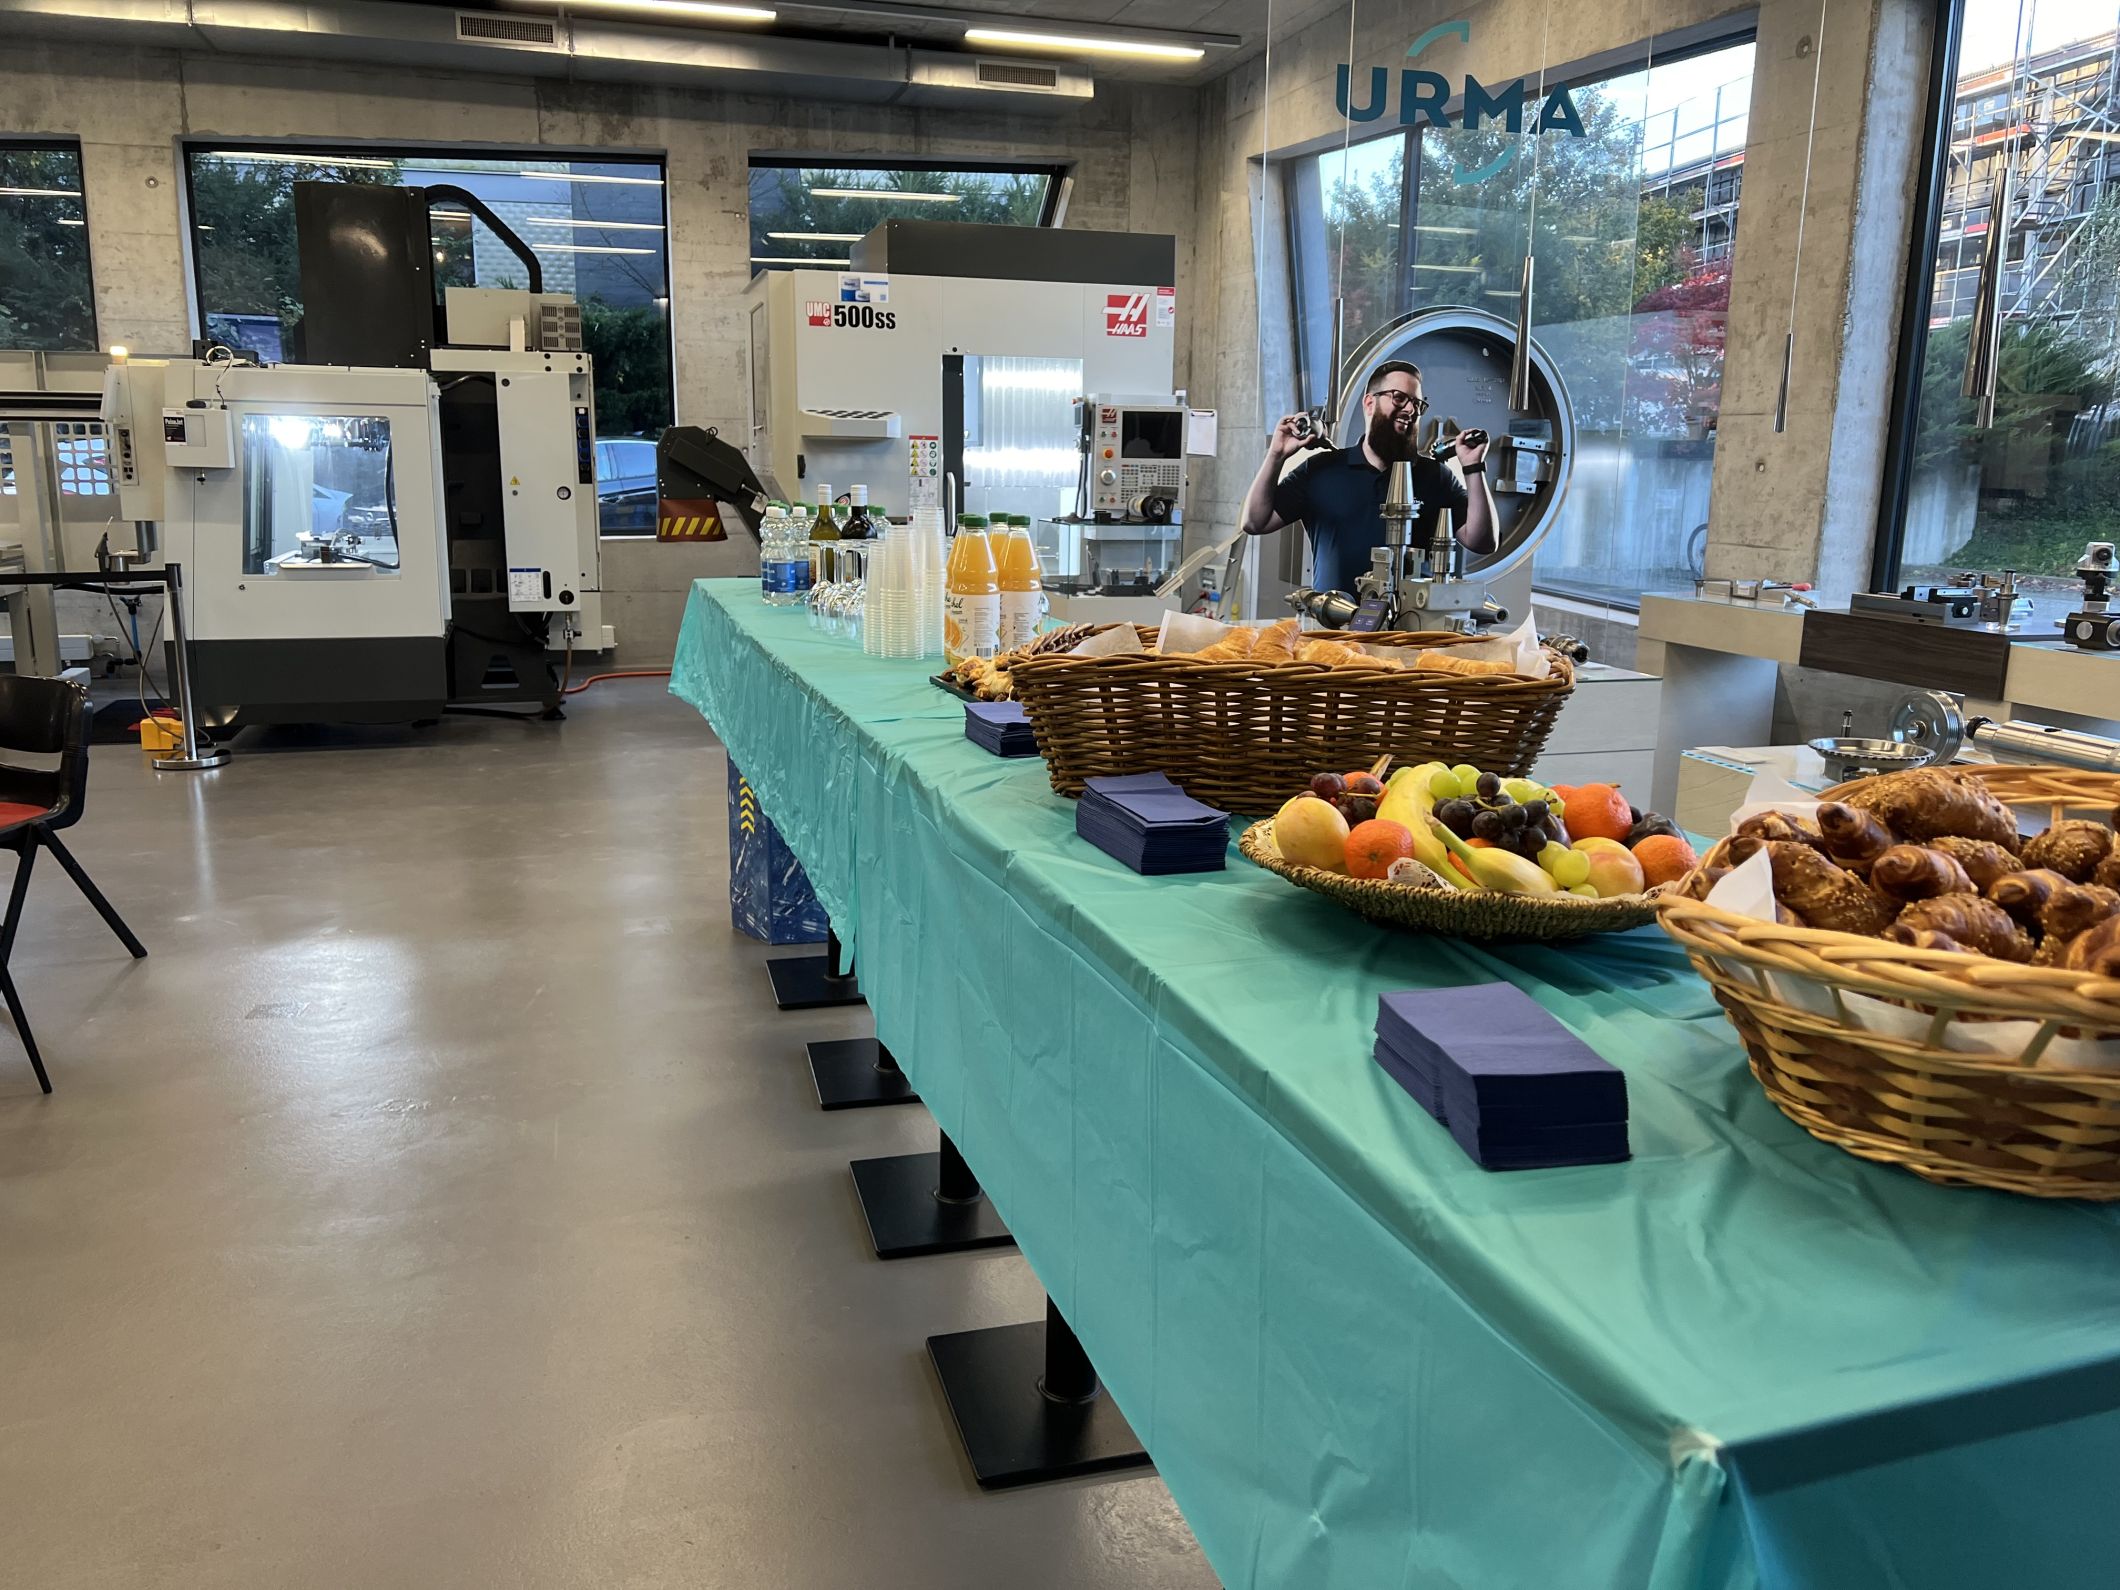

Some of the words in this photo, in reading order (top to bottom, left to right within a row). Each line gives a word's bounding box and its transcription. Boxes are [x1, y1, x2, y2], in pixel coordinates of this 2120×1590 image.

[1336, 63, 1587, 138] URMA
[806, 302, 830, 318] UMC
[1106, 323, 1147, 335] HAAS
